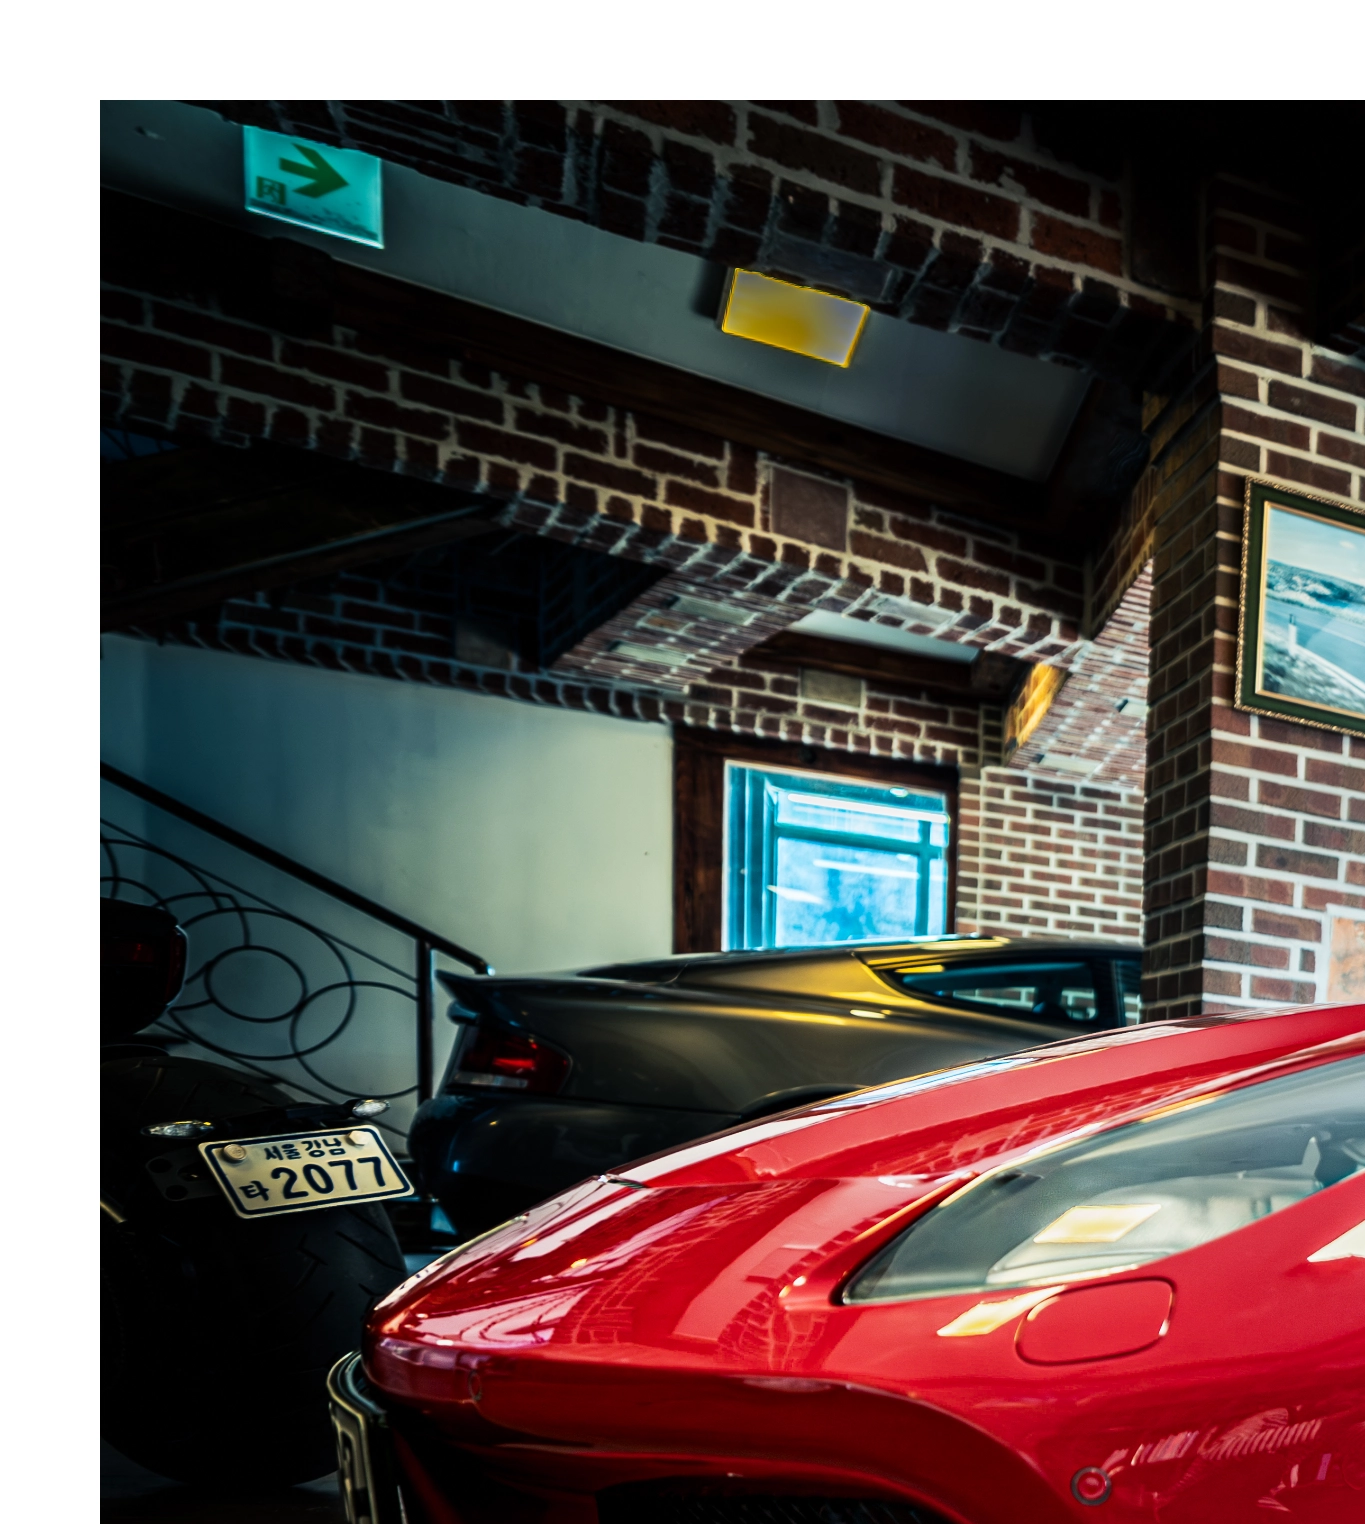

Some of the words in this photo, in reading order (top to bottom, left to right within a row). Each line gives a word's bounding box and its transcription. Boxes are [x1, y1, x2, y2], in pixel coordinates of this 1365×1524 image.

[264, 1143, 301, 1161] 서울
[301, 1138, 347, 1158] 강남
[239, 1180, 270, 1201] 타
[270, 1156, 386, 1200] 2077
